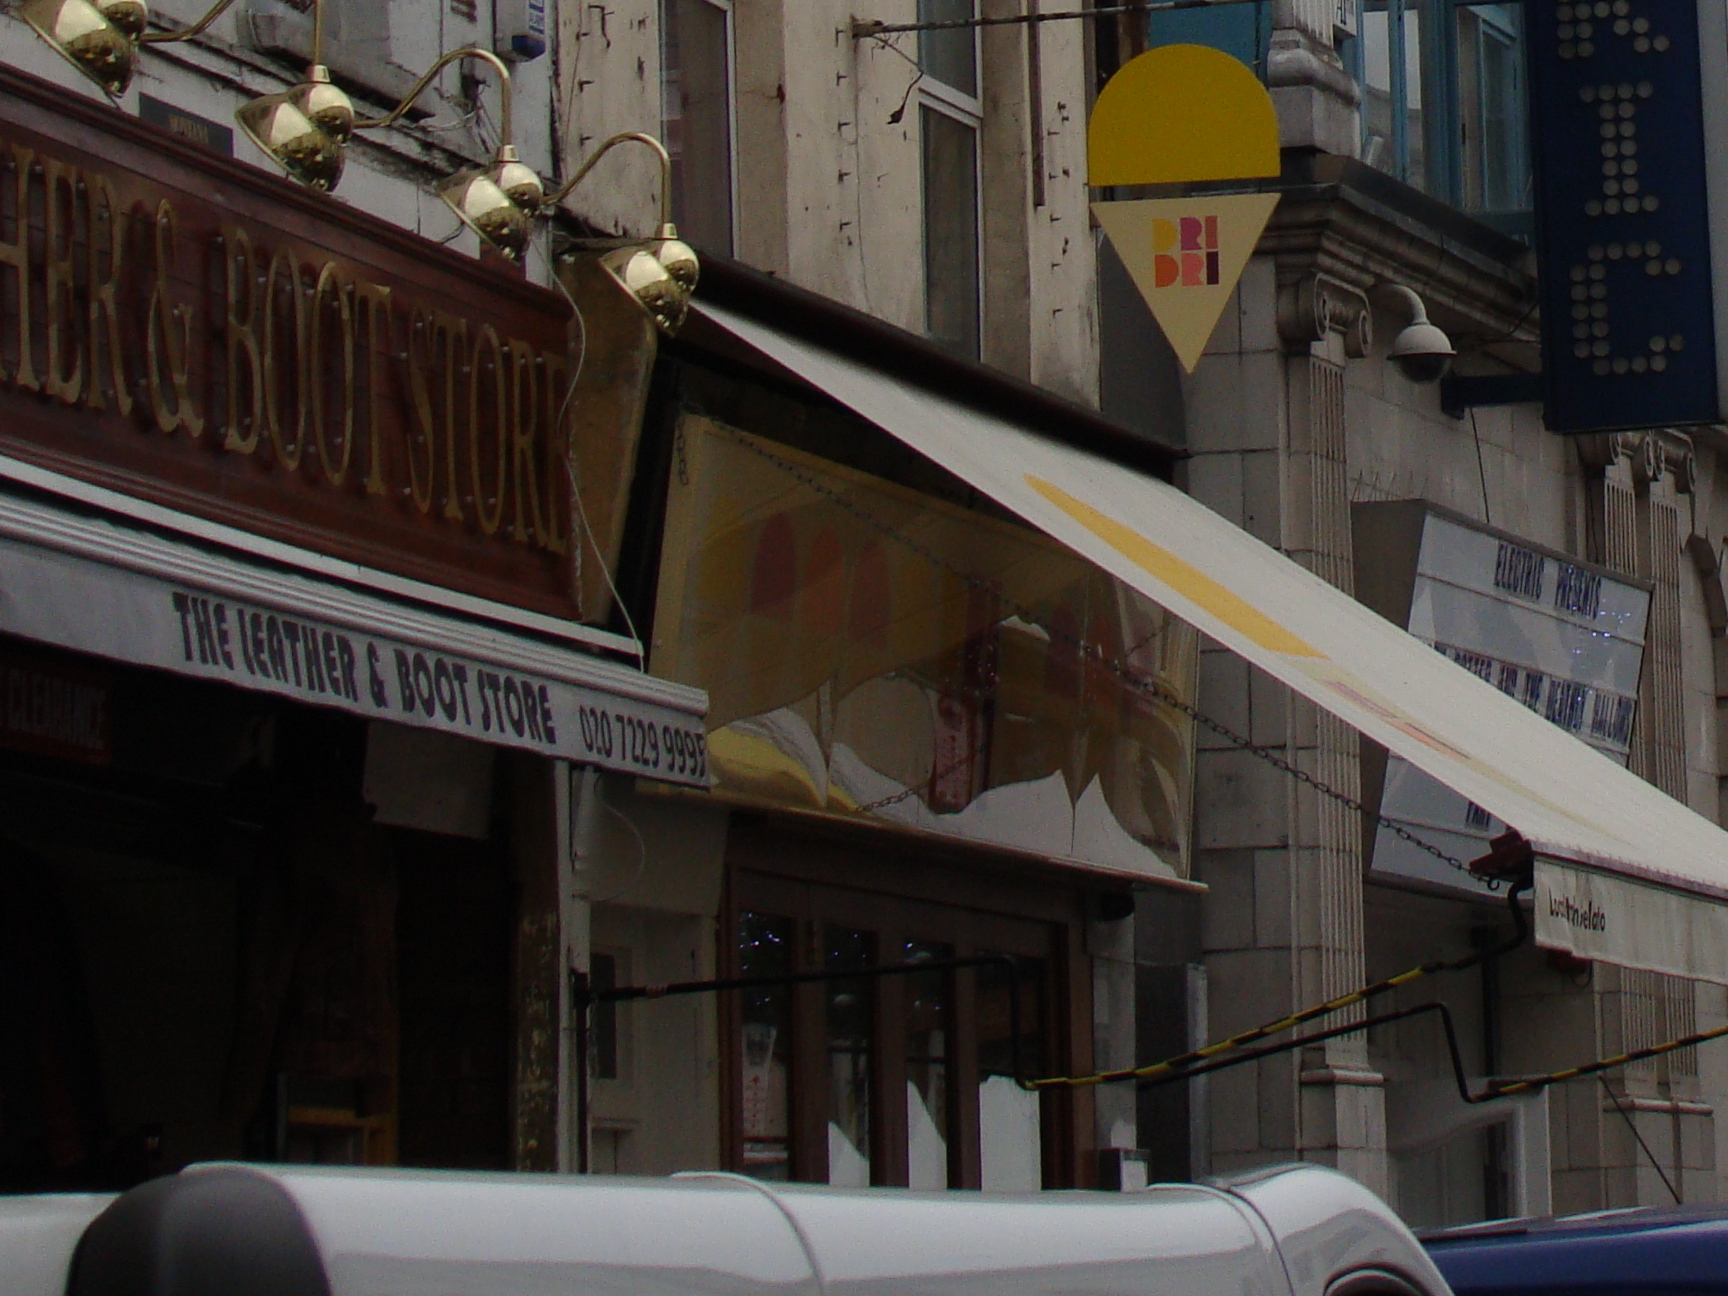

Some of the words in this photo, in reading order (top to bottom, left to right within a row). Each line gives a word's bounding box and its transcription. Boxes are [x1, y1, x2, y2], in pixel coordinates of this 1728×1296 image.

[1152, 215, 1219, 253] DRI
[1154, 250, 1220, 289] DRI
[147, 198, 205, 437] &
[222, 225, 393, 496] BOOT
[406, 306, 569, 555] STORE
[1494, 541, 1546, 601] ELECTRIC
[1554, 561, 1602, 621] PRESENTS
[172, 591, 235, 671] THE
[236, 607, 360, 703] LEATHER
[366, 640, 389, 709] &
[393, 648, 472, 726] BOOT
[477, 668, 557, 744] STORE
[579, 704, 613, 758] 020
[615, 713, 660, 769] 7229
